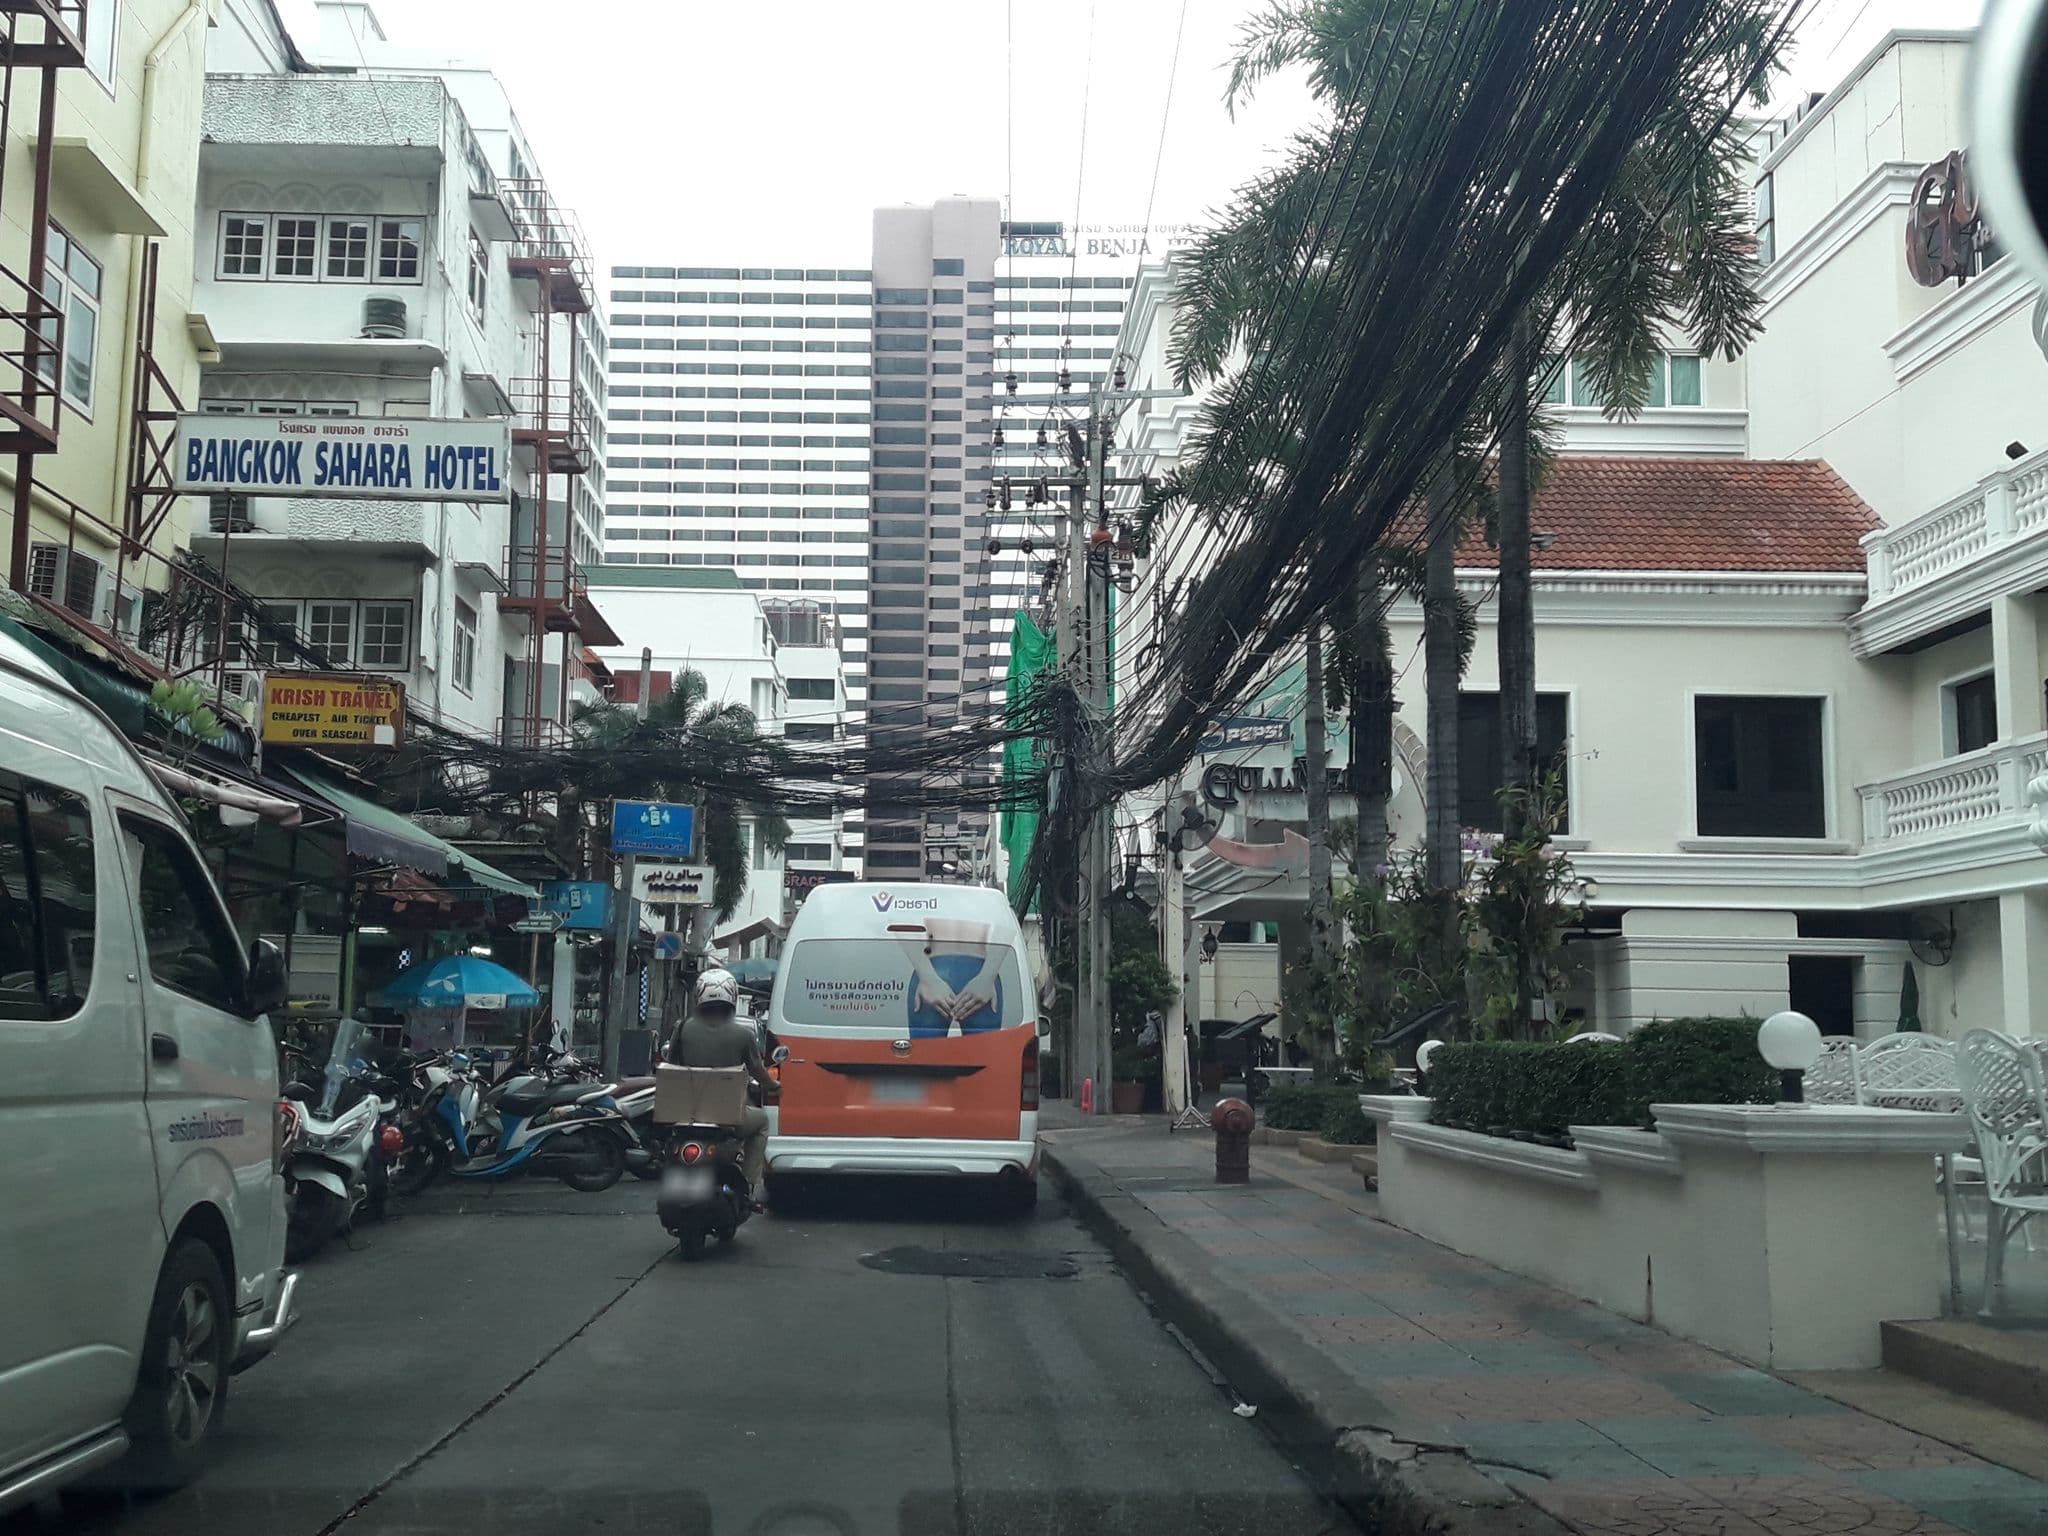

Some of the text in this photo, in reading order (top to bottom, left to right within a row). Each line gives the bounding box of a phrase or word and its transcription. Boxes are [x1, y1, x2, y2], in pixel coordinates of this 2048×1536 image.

[1003, 238, 1075, 256] ROYAL
[1087, 239, 1152, 256] BENJA
[186, 438, 500, 491] BANGKOK SAHARA HOTEL
[271, 688, 392, 709] KRISH TRAVEL
[271, 711, 387, 726] CHEAPEST AIR TICKET
[292, 729, 317, 738] OVER
[1226, 724, 1283, 743] PEPSI
[784, 876, 826, 889] GRACE
